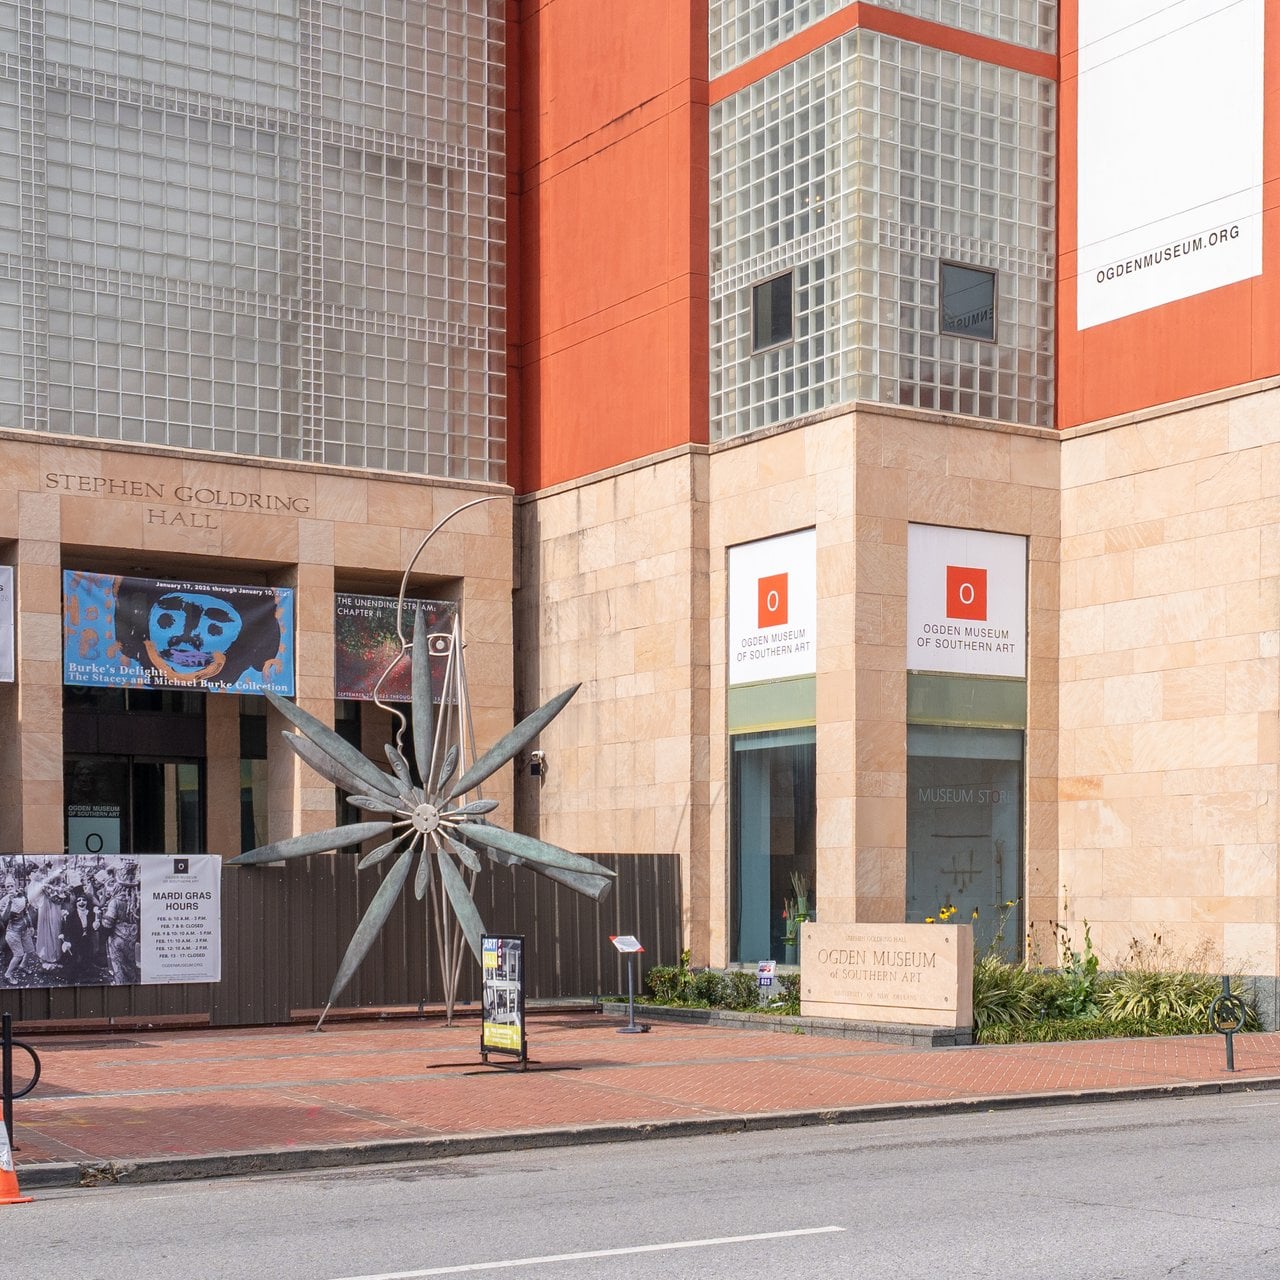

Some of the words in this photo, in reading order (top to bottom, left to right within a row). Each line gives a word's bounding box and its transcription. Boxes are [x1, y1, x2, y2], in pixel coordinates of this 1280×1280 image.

[1096, 225, 1240, 284] OGDENMUSEUM.ORG
[45, 472, 165, 498] STEPHEN
[174, 486, 310, 513] GOLDRING
[147, 508, 218, 530] HALL
[156, 581, 181, 590] January
[212, 586, 237, 594] through
[238, 588, 263, 596] January
[264, 589, 274, 597] 10,
[337, 597, 352, 605] THE
[355, 599, 399, 609] UNENDING
[403, 603, 437, 612] STRAM:
[337, 608, 374, 618] CHAPTER
[741, 635, 769, 648] OGDEN
[771, 628, 806, 643] MUSEUM
[923, 623, 961, 635] OGDEN
[964, 627, 1009, 640] MUSEUM
[736, 652, 747, 662] OF
[749, 645, 793, 660] SOUTHERN
[794, 641, 811, 652] ART
[917, 637, 931, 647] OF
[935, 638, 992, 652] SOUTHERN
[995, 643, 1016, 653] ART
[68, 662, 115, 674] Burke's
[119, 664, 168, 677] Delight:
[68, 671, 90, 681] The
[92, 673, 128, 684] Stacey
[130, 675, 151, 684] and
[154, 676, 197, 687] Michael
[200, 679, 232, 689] Burke
[918, 788, 974, 803] MUSEUM
[977, 790, 1013, 804] STORE
[152, 892, 183, 900] MARDI
[185, 891, 212, 900] GRAS
[165, 902, 199, 911] HOURS
[818, 948, 866, 965] OGDEN
[872, 950, 936, 968] MUSEUM
[830, 969, 839, 979] of
[842, 969, 897, 982] SOUTHERN
[901, 972, 923, 983] ART
